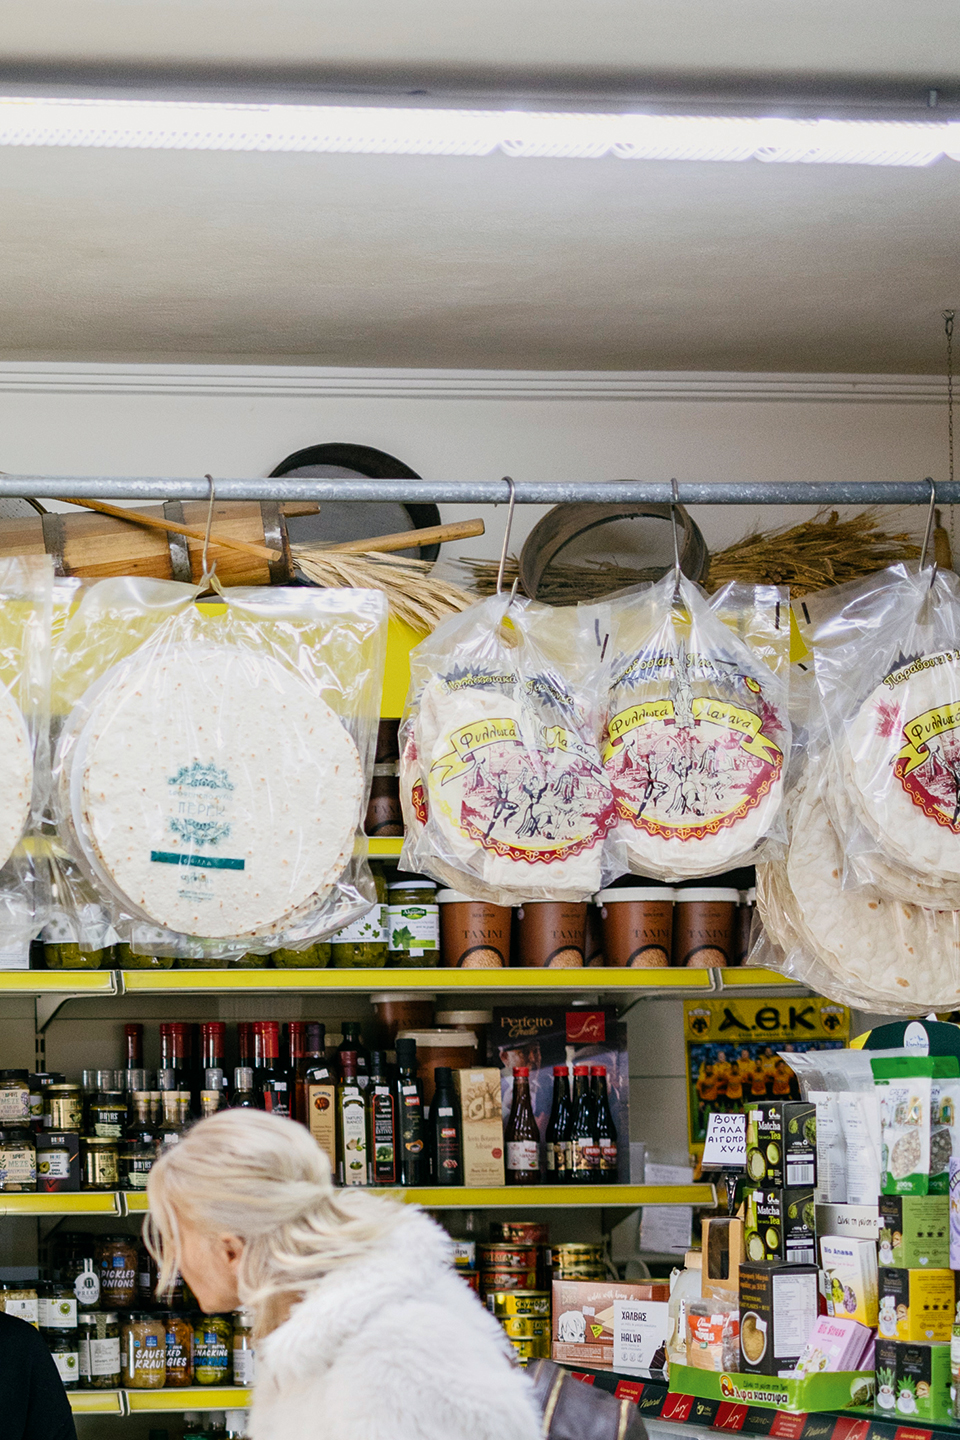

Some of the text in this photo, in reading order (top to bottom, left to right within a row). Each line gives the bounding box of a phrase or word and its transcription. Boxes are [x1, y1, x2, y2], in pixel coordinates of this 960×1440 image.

[611, 704, 752, 733] Φυλλωτά Λαχανά
[460, 725, 516, 750] Φυλλωτά
[178, 801, 226, 817] ΠΕΡΕΚ
[501, 1017, 553, 1028] Perfetto
[758, 1121, 781, 1130] Matcha
[757, 1206, 780, 1215] Matcha
[769, 1216, 780, 1224] Tea
[824, 1246, 832, 1254] Bio
[101, 1270, 135, 1278] PICKLED
[102, 1279, 134, 1288] ONIONS
[621, 1311, 647, 1322] ΧΑΛΒΑΣ
[621, 1333, 642, 1343] HALVA
[136, 1350, 164, 1359] SAUER
[194, 1349, 228, 1357] SNACKING
[135, 1360, 164, 1369] KRAUT
[167, 1358, 187, 1367] GIES
[194, 1357, 228, 1366] PICKLES
